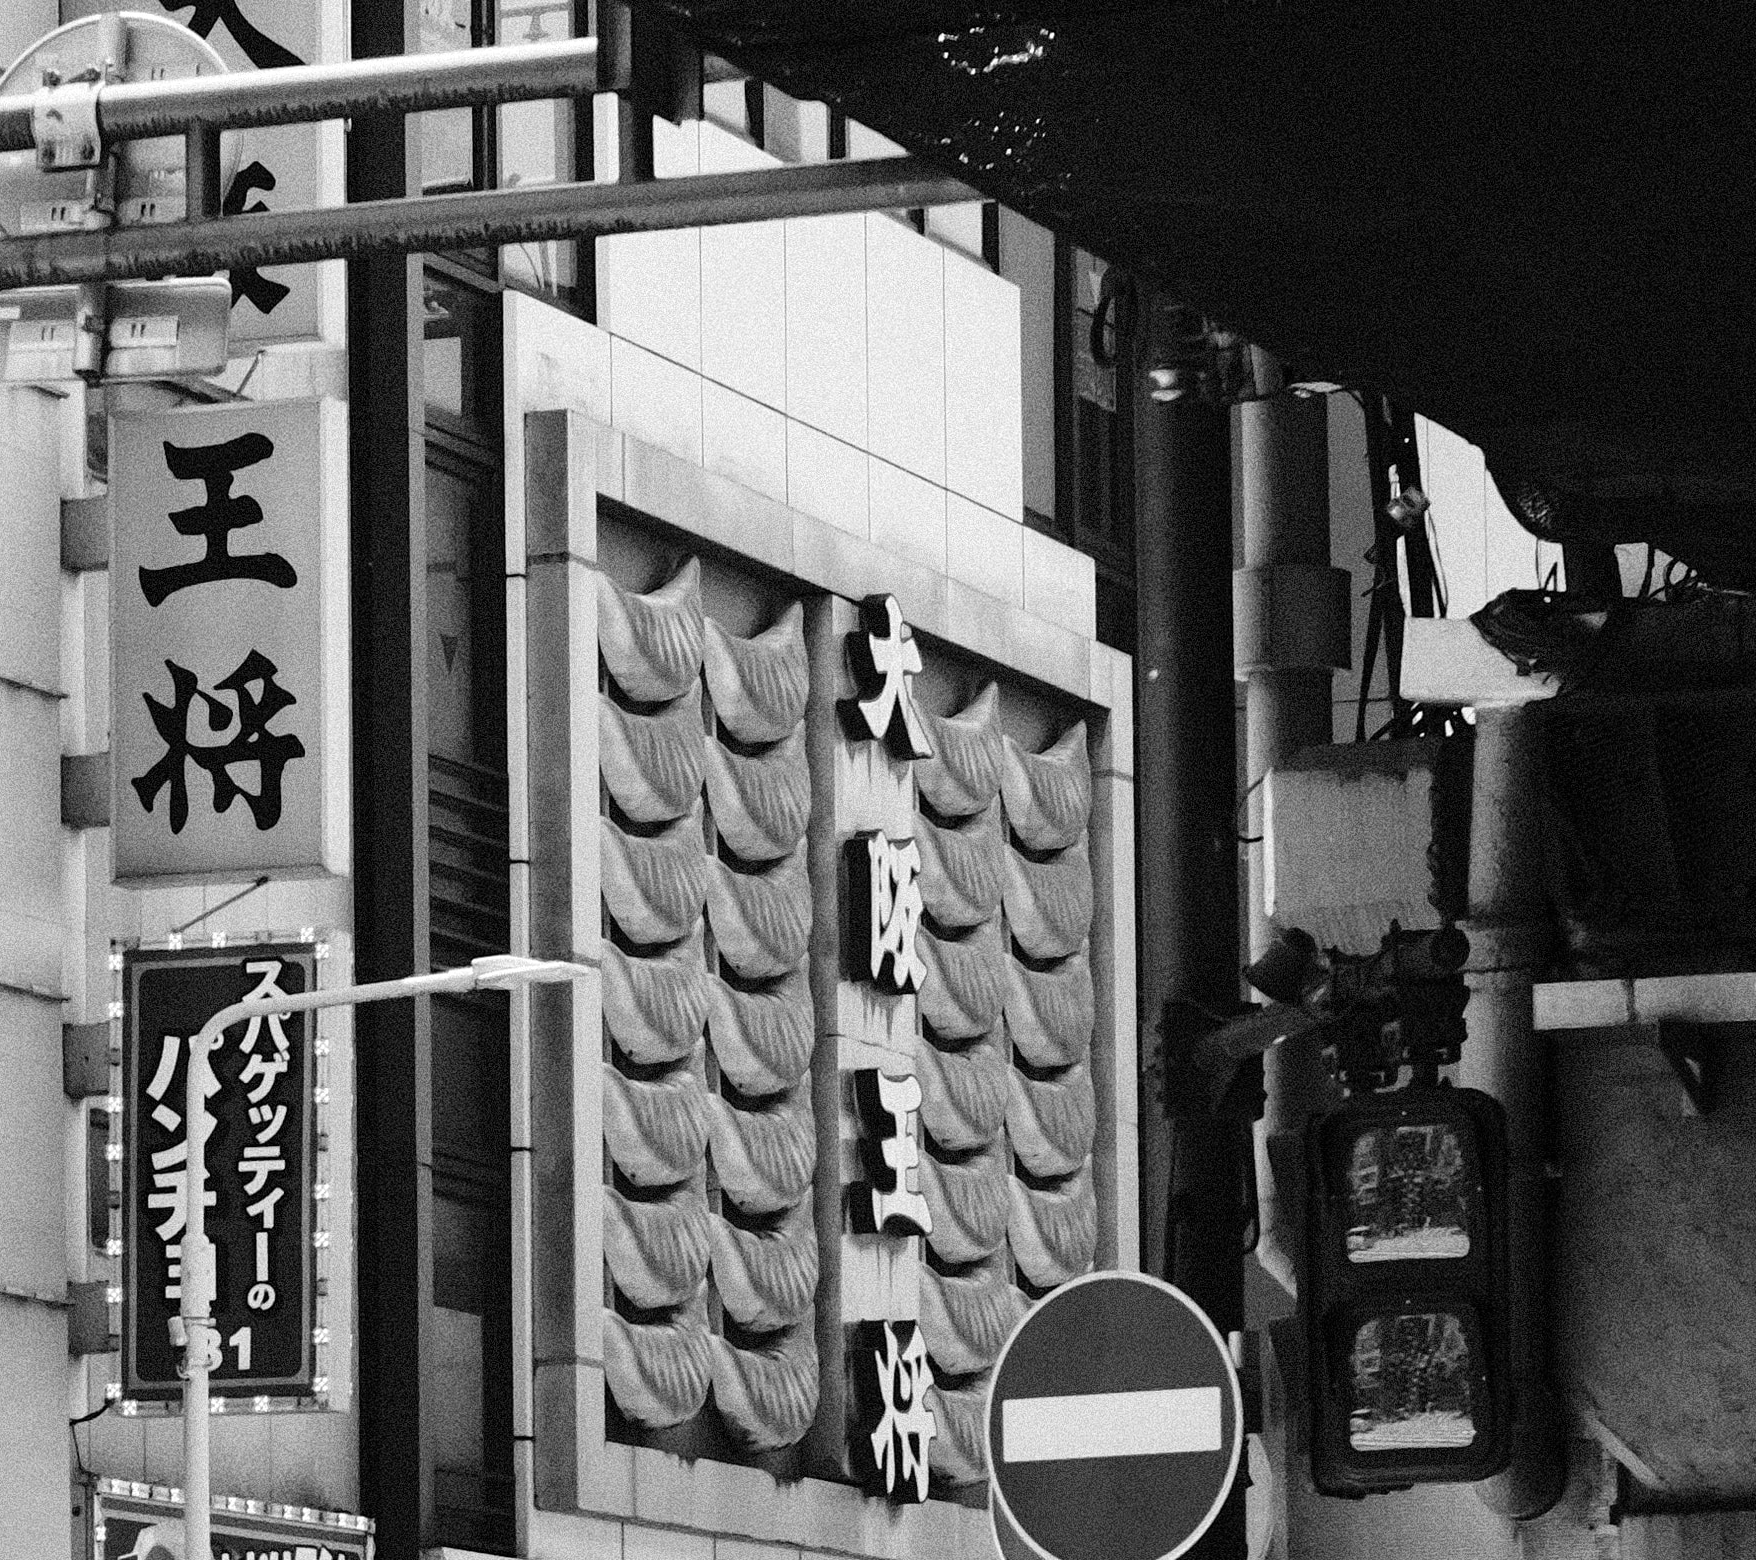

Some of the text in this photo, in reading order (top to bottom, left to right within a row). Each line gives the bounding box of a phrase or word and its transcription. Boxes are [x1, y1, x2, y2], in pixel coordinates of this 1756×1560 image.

[239, 959, 293, 1311] スパゲッティーの
[856, 593, 938, 1506] 大阪王将
